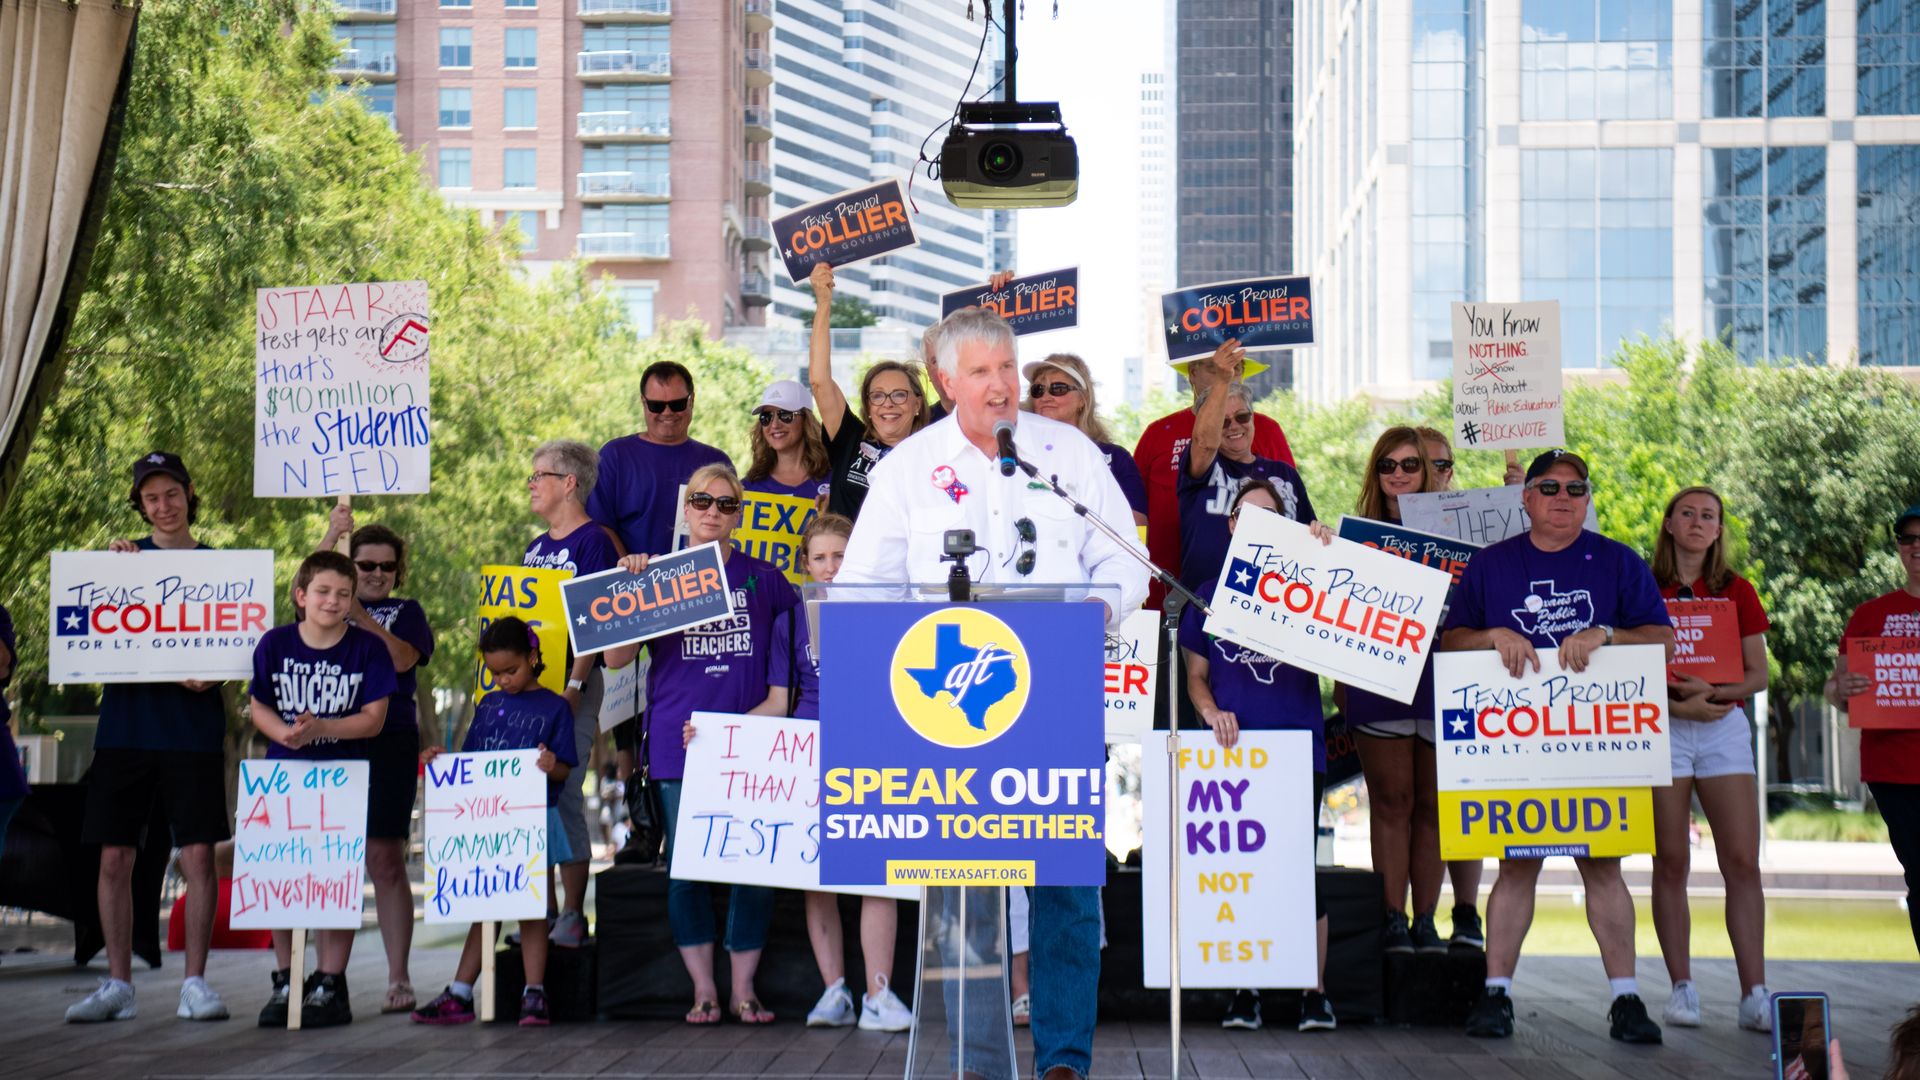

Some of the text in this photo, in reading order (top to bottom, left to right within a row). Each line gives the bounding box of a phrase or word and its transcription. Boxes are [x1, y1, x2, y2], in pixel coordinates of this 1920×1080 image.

[791, 200, 907, 255] COLLIER
[841, 224, 908, 250] GOVERNOR
[260, 284, 394, 331] STAAR
[1182, 296, 1311, 332] COLLIER
[1463, 305, 1541, 338] You Know
[259, 329, 302, 351] test
[306, 324, 350, 352] gets
[355, 326, 385, 343] an
[383, 319, 429, 357] F
[1186, 331, 1208, 343] FOR
[1238, 321, 1310, 335] GOVERNOR
[259, 355, 335, 384] that's
[1465, 363, 1487, 376] Jon
[264, 380, 415, 418] $90 million
[1462, 381, 1489, 400] Greg
[1455, 401, 1481, 416] about
[260, 404, 429, 455] the Students
[283, 450, 401, 495] NEED.
[736, 500, 819, 536] TEXA
[1442, 505, 1512, 543] THEY
[590, 567, 722, 622] COLLIER
[91, 602, 267, 635] COLLIER
[596, 620, 622, 633] FOR
[652, 593, 723, 618] GOVERNOR
[1258, 571, 1427, 654] COLLIER
[67, 636, 256, 650] FOR LT. GOVERNOR
[684, 632, 751, 656] TEACHERS
[1229, 595, 1262, 615] FOR
[1270, 611, 1295, 629] LT.
[1305, 621, 1407, 666] GOVERNOR
[283, 657, 342, 676] I'm the
[944, 641, 1017, 708] aft
[1875, 668, 1920, 682] DEM
[1477, 702, 1662, 738] COLLIER
[720, 724, 815, 767] I AM
[1179, 747, 1269, 770] FUND
[1454, 740, 1652, 756] FOR LT. GOVERNOR
[241, 762, 349, 796] We are
[427, 756, 522, 788] WE are
[720, 769, 797, 804] THAN
[824, 767, 978, 806] SPEAK
[990, 767, 1101, 806] OUT!
[241, 793, 346, 831] ALL
[1187, 778, 1250, 813] MY
[826, 814, 1102, 840] STAND TOGETHER.
[1460, 796, 1628, 835] PROUD!
[238, 834, 364, 865] worth the
[692, 814, 794, 864] TEST
[1186, 819, 1267, 856] KID
[1508, 846, 1586, 858] WWW.TEXASAFT.ORG
[433, 863, 530, 917] future
[894, 867, 1028, 880] WWW.TEXASAFT.ORG
[1198, 872, 1255, 894] NOT
[233, 866, 360, 917] Investment!
[1216, 901, 1236, 923] A
[1197, 940, 1274, 964] TEST
